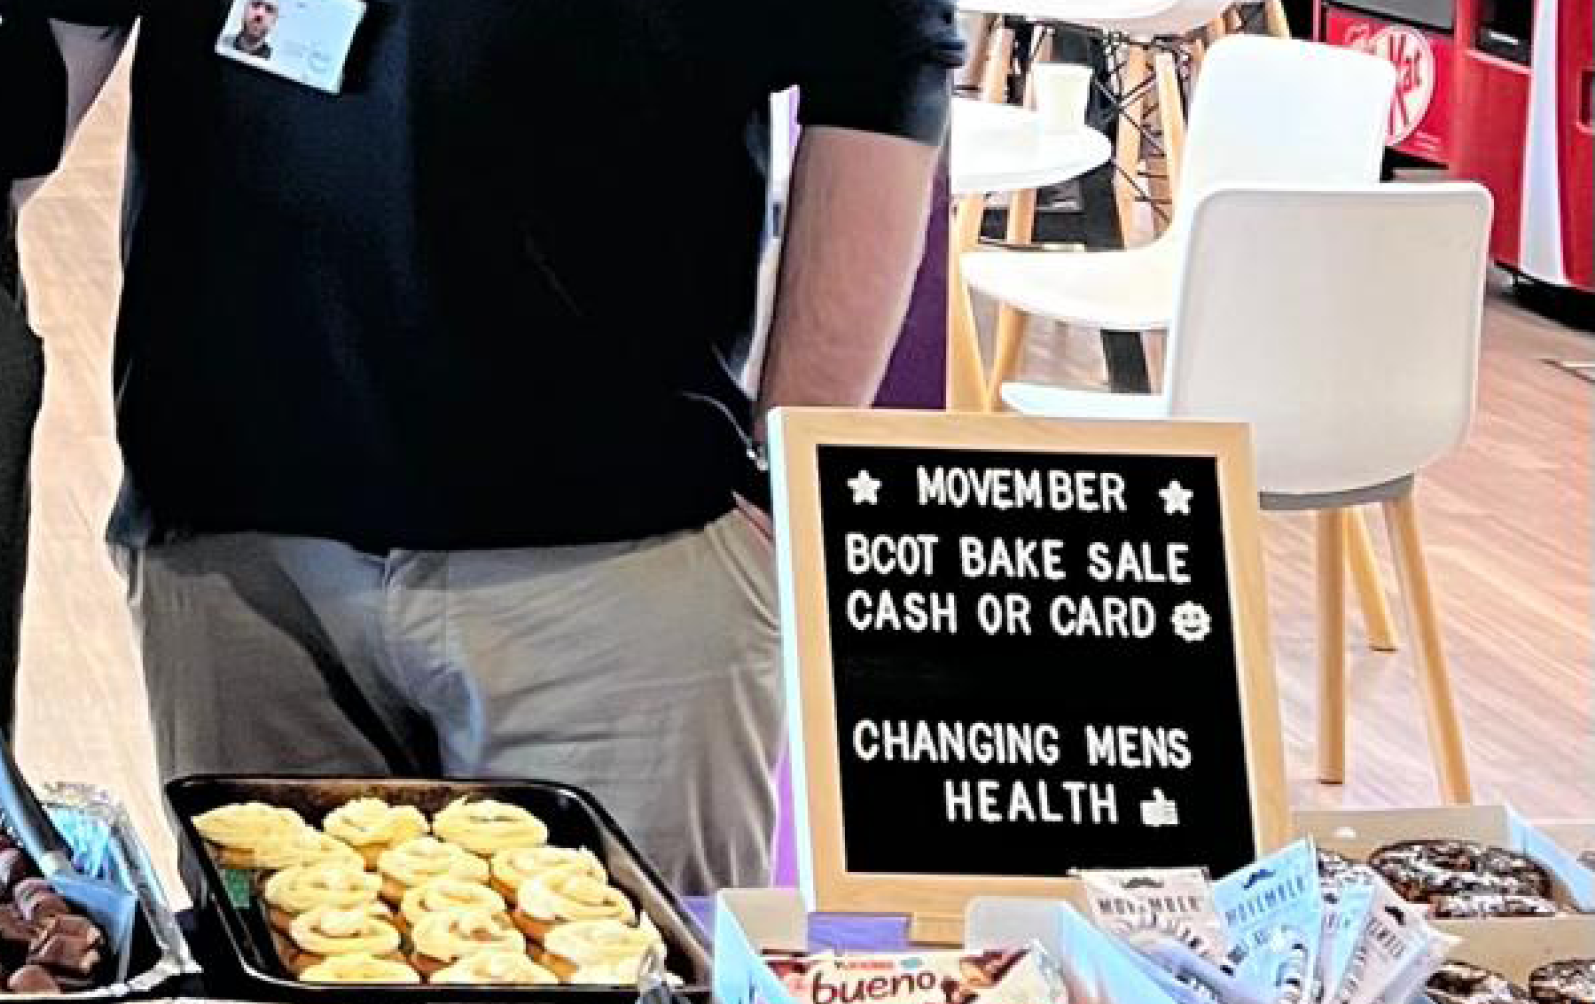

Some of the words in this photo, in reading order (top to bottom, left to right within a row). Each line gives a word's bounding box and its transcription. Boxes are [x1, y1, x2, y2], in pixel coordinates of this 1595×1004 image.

[916, 466, 1127, 512] MOVEMBER
[845, 532, 939, 575] BCOT
[959, 536, 1066, 580] BAKE
[1087, 541, 1192, 584] SALE
[846, 589, 957, 634] CASH
[977, 593, 1032, 635] OR
[1050, 596, 1156, 638] CARD
[853, 719, 1060, 765] CHANGING
[1086, 724, 1193, 769] MENS
[944, 779, 1119, 824] HEALTH
[812, 969, 936, 1004] bueno
